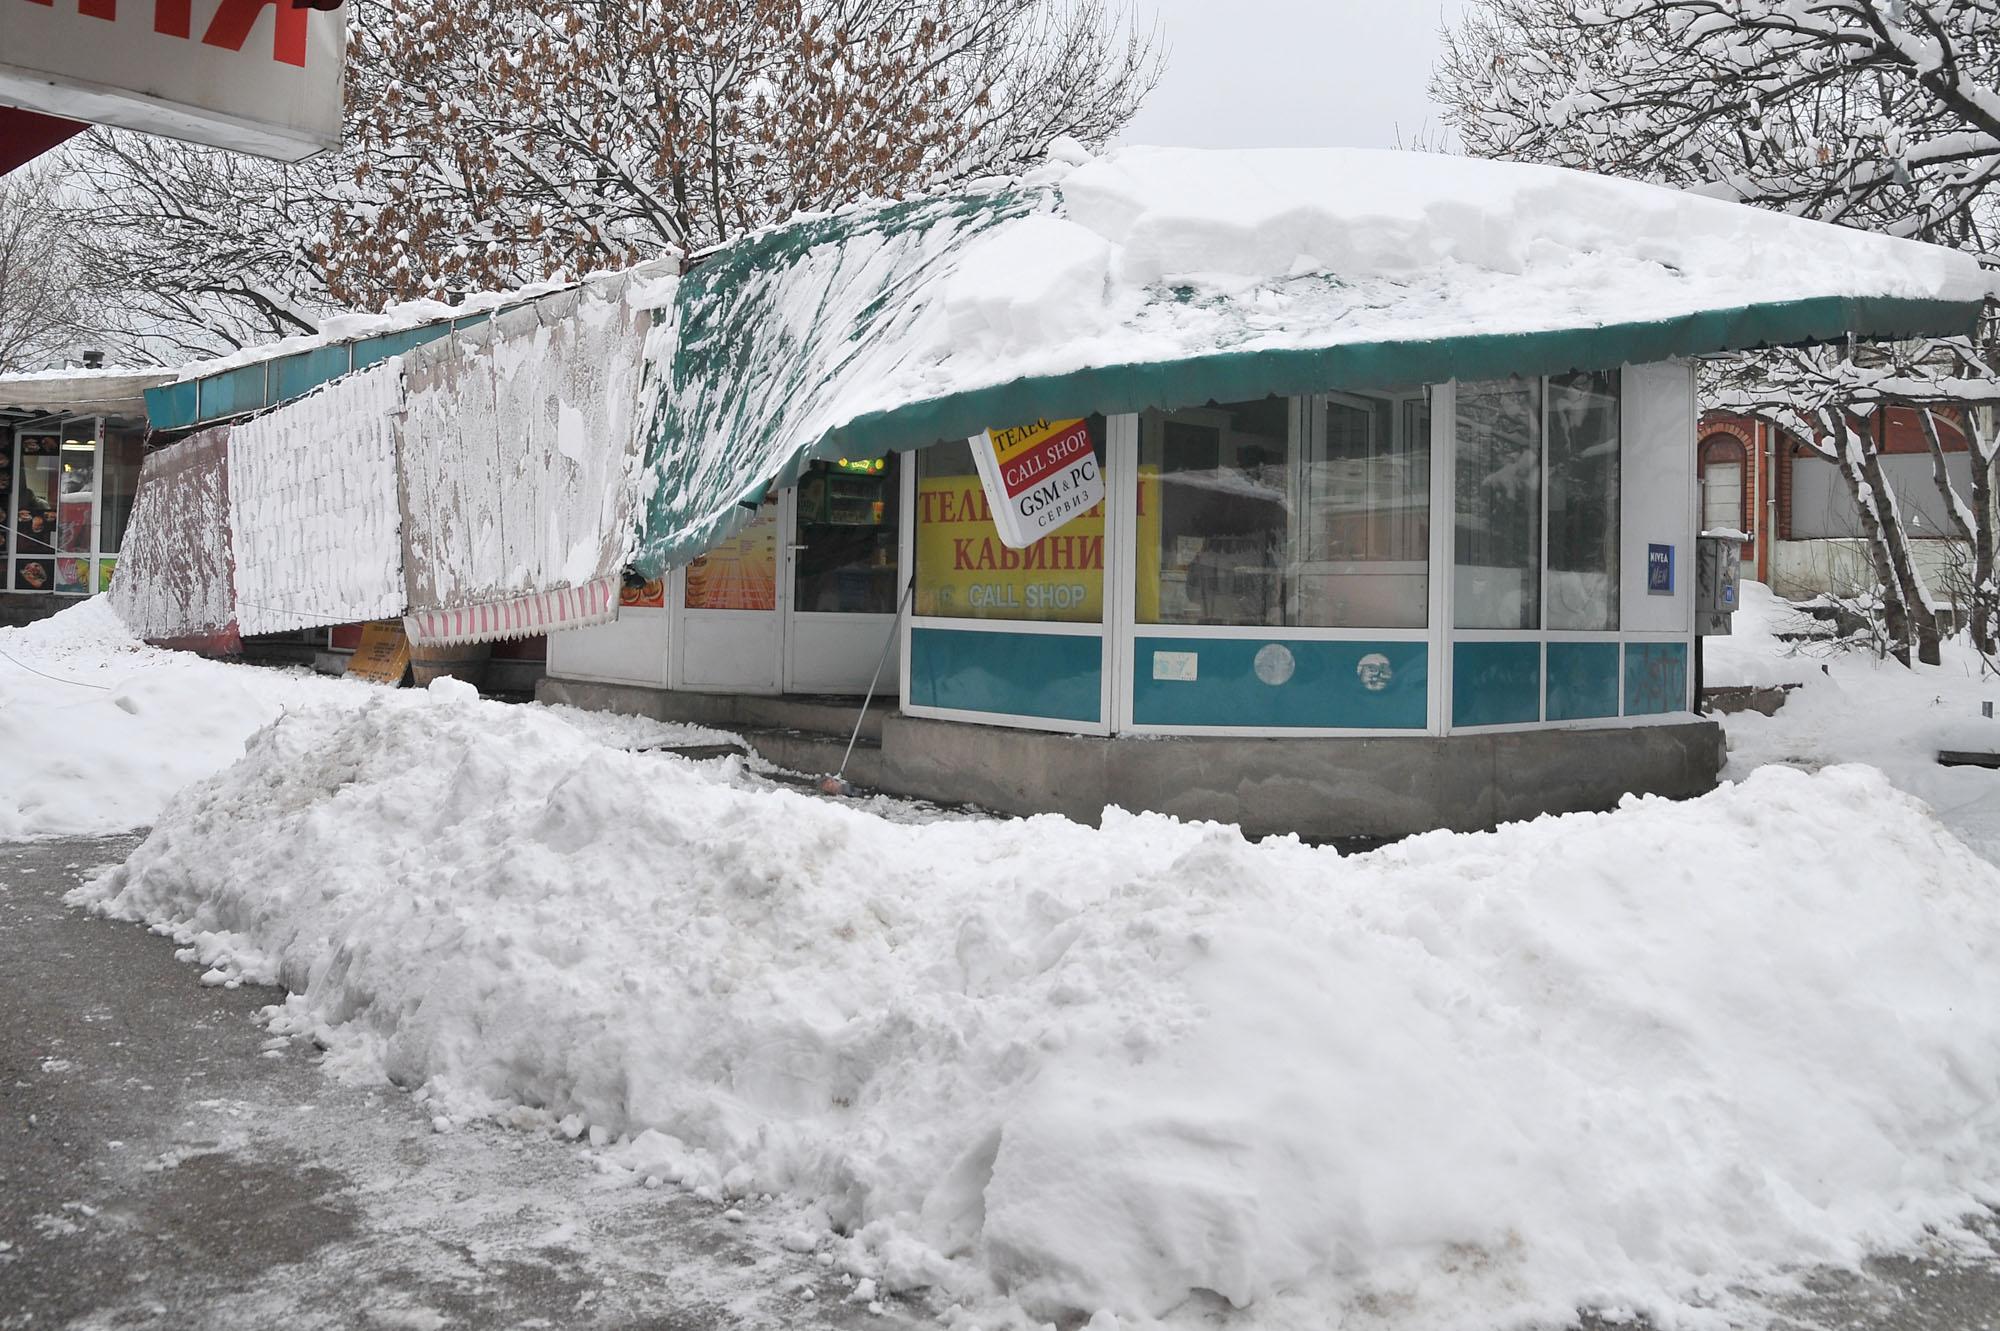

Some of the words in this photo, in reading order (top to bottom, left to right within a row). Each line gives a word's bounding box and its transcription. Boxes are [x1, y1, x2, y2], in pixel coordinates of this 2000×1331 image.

[1006, 455, 1047, 487] CALL
[1046, 430, 1087, 465] SHOP
[1020, 481, 1061, 517] GSM
[1062, 480, 1070, 492] &
[1070, 461, 1095, 488] PC
[1038, 490, 1089, 527] СЕРВИЗ
[953, 535, 1105, 571] КАБИНИ
[1650, 552, 1669, 563] NIVEA
[968, 583, 1019, 608] CALL
[1025, 584, 1086, 609] SHOP
